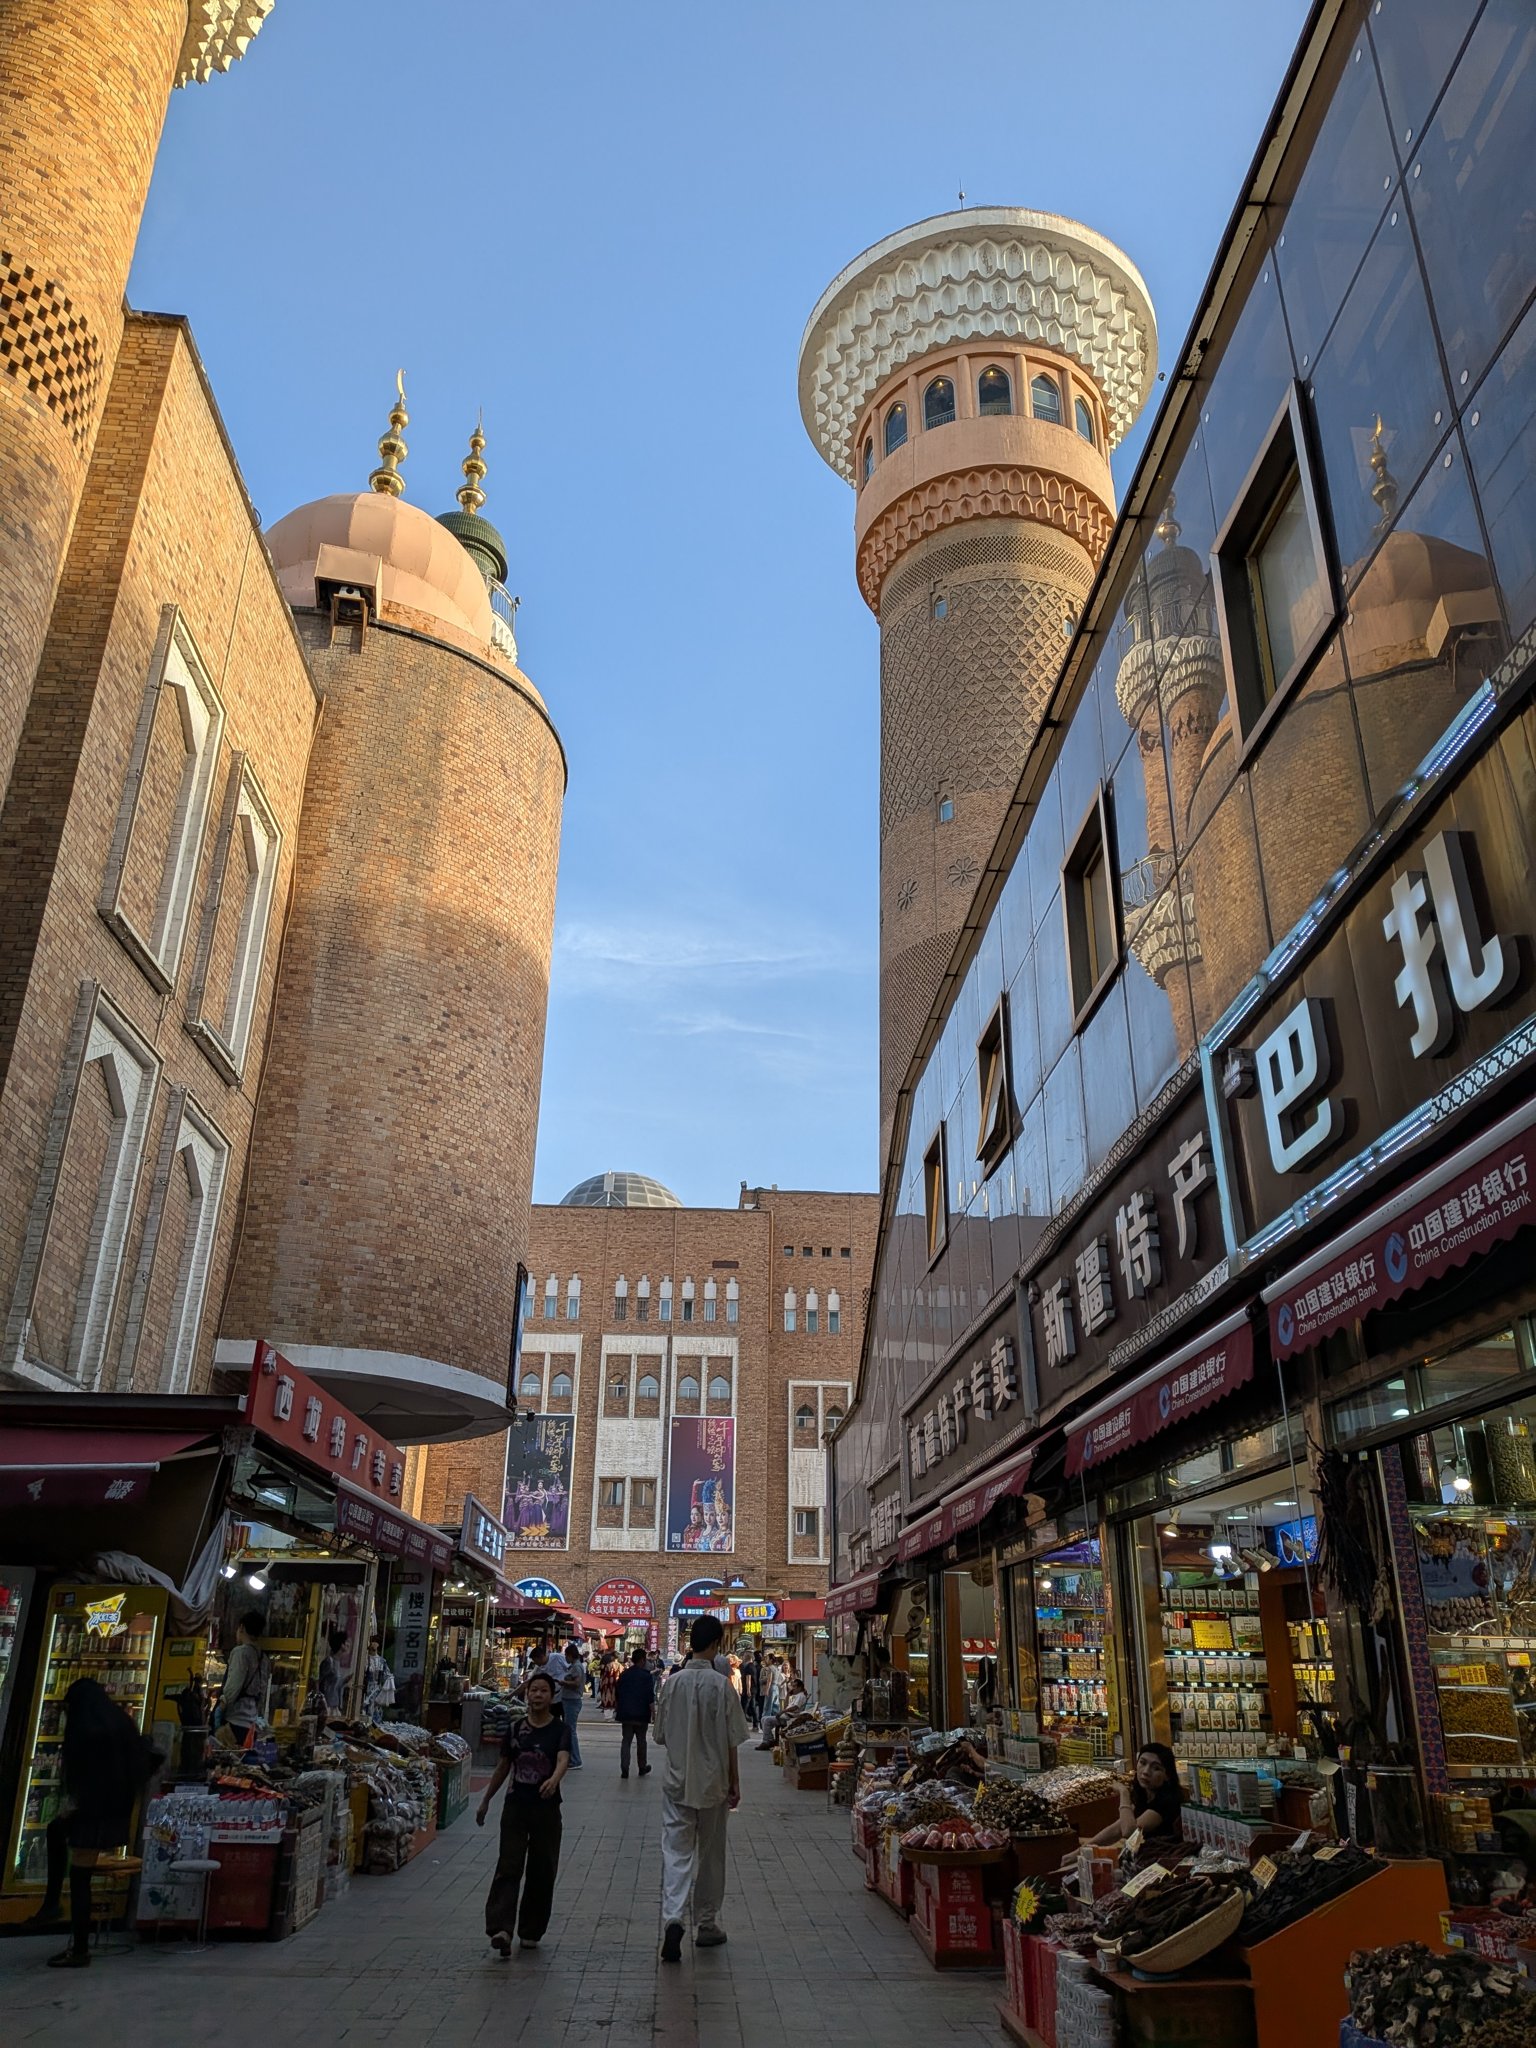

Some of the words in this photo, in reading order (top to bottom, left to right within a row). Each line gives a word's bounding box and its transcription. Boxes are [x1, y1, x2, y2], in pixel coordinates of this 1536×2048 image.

[1256, 831, 1504, 1173] 巴扎
[1408, 1154, 1528, 1250] 中国建设银行
[1414, 1242, 1440, 1268] China
[1440, 1211, 1500, 1252] Construction
[1502, 1190, 1532, 1221] Bank
[1043, 1131, 1213, 1367] 新疆特产
[1294, 1252, 1376, 1320] 中国建设银行
[1298, 1316, 1317, 1336] China
[1317, 1295, 1358, 1326] Construction
[1358, 1282, 1378, 1303] Bank
[910, 1337, 1016, 1478] 新疆特产专卖
[1171, 1351, 1226, 1396] 中国建设银行
[273, 1374, 402, 1496] 西域特产专卖
[1093, 1408, 1132, 1442] 中国建设银行
[403, 1591, 424, 1668] 楼兰名品
[594, 1595, 631, 1604] 英吉沙小刀
[632, 1595, 647, 1604] 专卖
